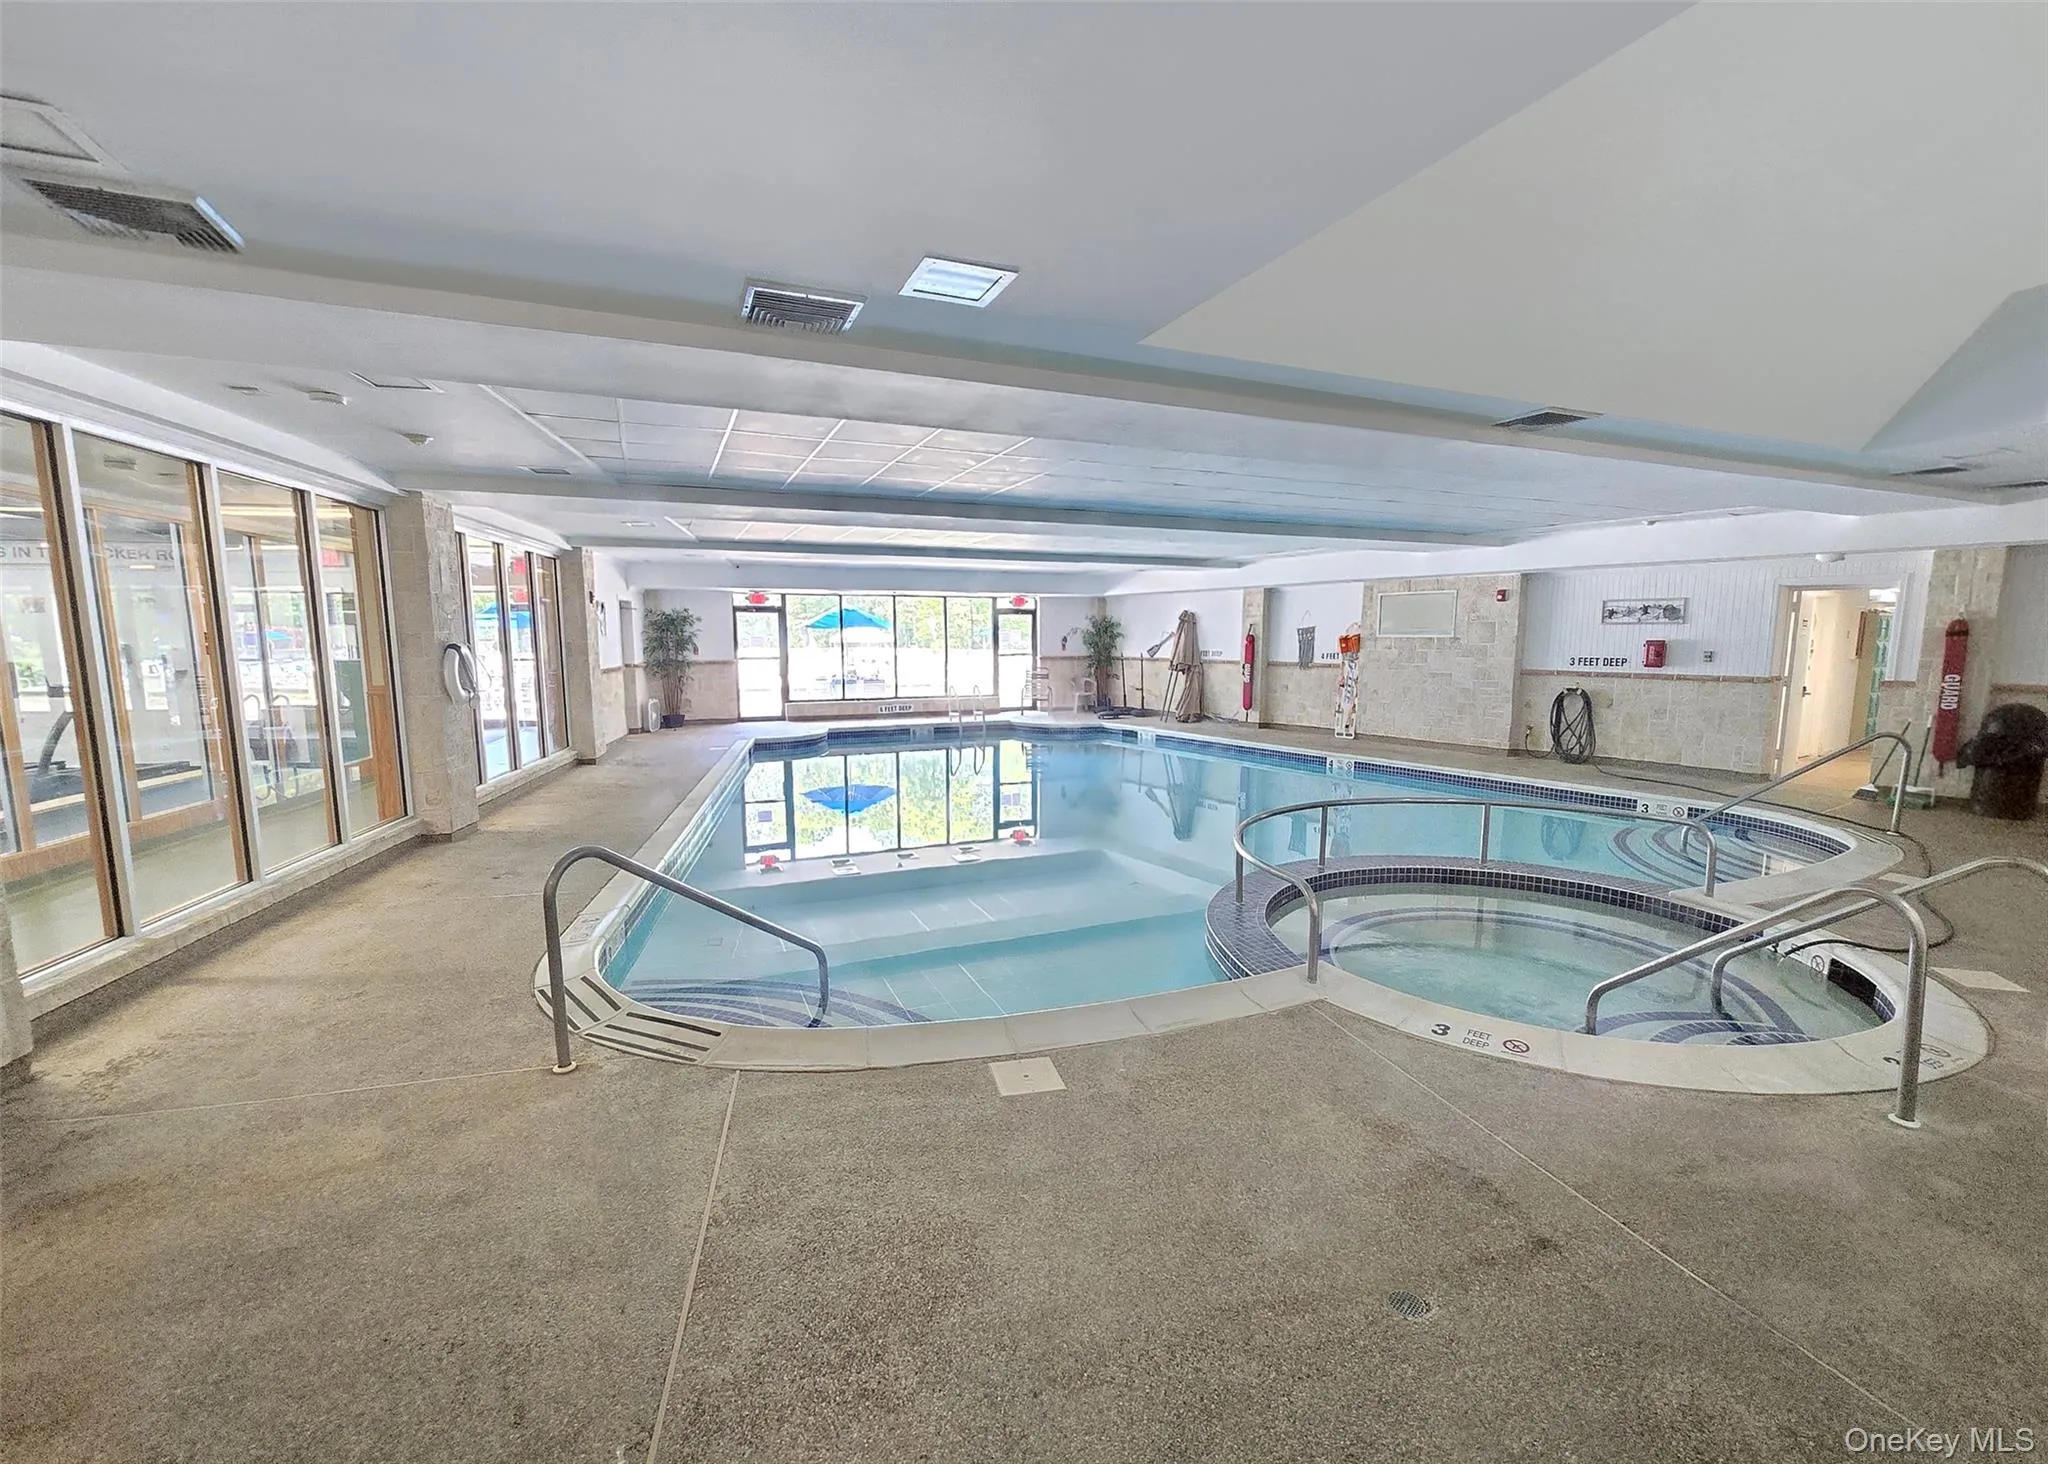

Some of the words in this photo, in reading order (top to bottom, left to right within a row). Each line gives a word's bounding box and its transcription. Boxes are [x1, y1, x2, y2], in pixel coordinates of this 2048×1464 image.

[12, 546, 31, 558] IN
[105, 547, 150, 559] CKER
[1569, 657, 1576, 666] 3
[1578, 657, 1600, 667] FEET
[1602, 657, 1628, 667] DEEP
[1940, 673, 1961, 710] GUARD
[1641, 803, 1649, 813] 3
[1431, 1023, 1451, 1036] 3
[1466, 1028, 1492, 1041] FEET
[1462, 1037, 1490, 1049] DEEP
